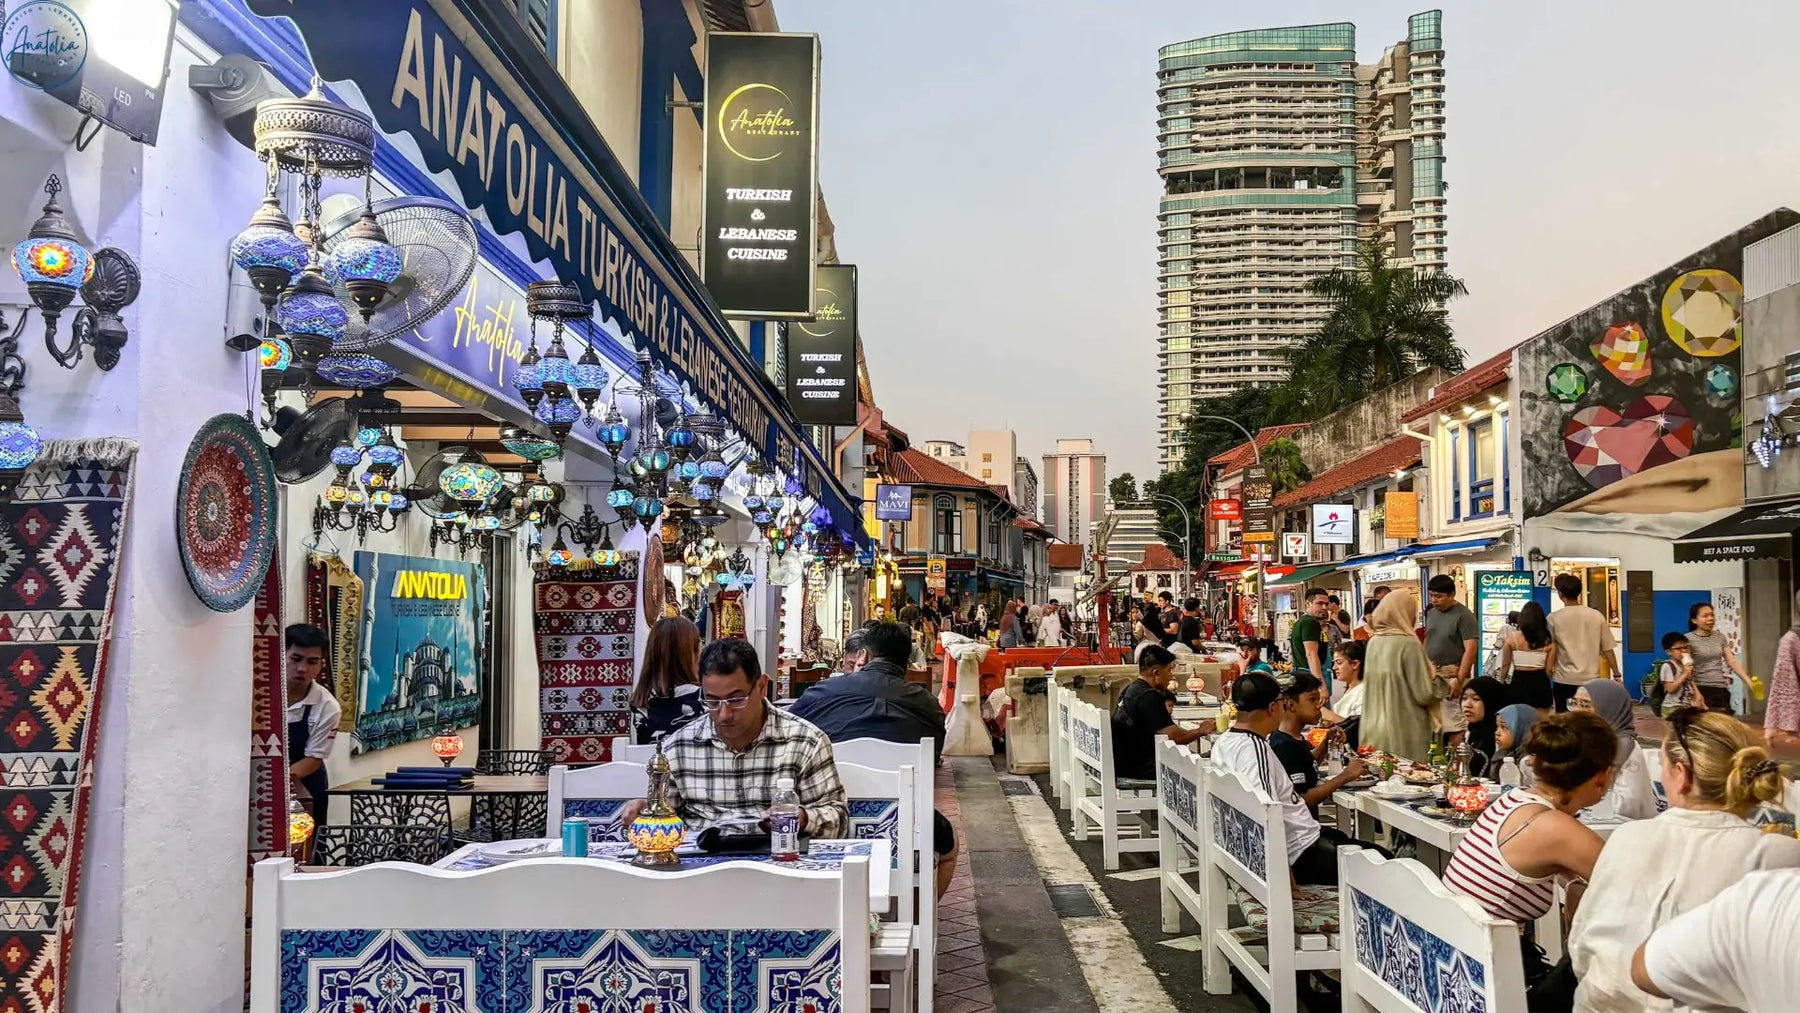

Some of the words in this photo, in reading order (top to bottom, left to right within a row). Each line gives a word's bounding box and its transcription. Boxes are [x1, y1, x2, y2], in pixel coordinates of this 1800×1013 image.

[113, 86, 131, 106] LED
[730, 107, 794, 134] Anatolia
[726, 188, 792, 201] TURKISH
[391, 7, 570, 263] ANATOLIA
[577, 195, 658, 343] TURKISH
[658, 295, 669, 356] &
[671, 305, 727, 411] LEBANESE
[750, 208, 766, 220] &
[718, 228, 797, 241] LEBANESE
[727, 248, 788, 260] CUISINE
[816, 302, 842, 321] atolia
[453, 274, 525, 387] Anatolia
[800, 353, 842, 362] TURKISH
[815, 366, 826, 374] &
[796, 378, 846, 387] LEBANESE
[801, 390, 840, 399] CUISINE
[879, 499, 909, 509] MAVI
[1723, 546, 1741, 554] SPACE
[1742, 545, 1756, 553] POD
[391, 569, 468, 600] ANATOLIA
[1493, 574, 1531, 588] Taksim
[1537, 569, 1548, 587] 2
